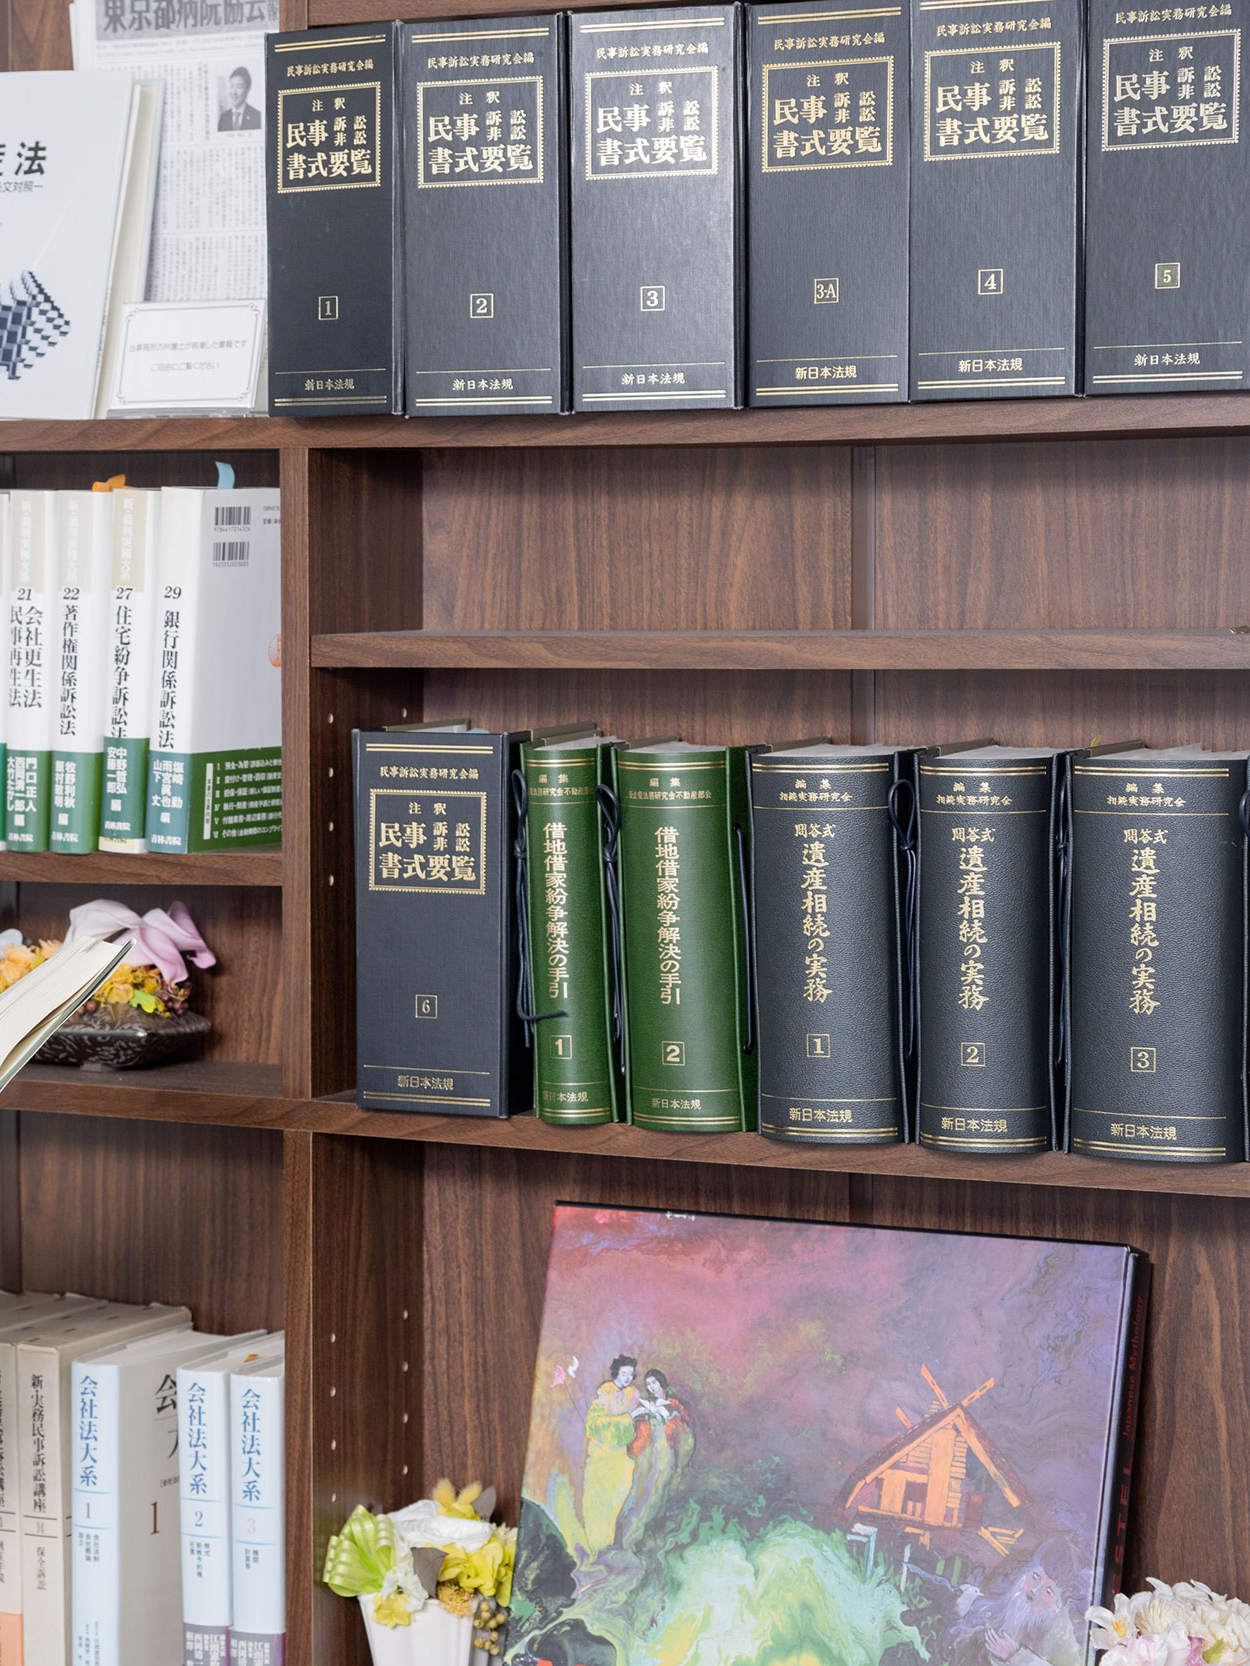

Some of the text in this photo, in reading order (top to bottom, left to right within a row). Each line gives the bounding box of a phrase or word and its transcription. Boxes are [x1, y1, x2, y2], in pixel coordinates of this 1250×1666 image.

[1116, 4, 1231, 24] 民事訴訟実務研究会編
[937, 17, 1051, 36] 民事訴訟実務研究会編
[775, 32, 884, 50] 民事訴訟実務研究会編
[597, 42, 708, 59] 民事訴訟実務研究会編
[1150, 47, 1193, 62] 注釈
[287, 59, 373, 76] 民事訴訟実務研究会編
[428, 52, 534, 69] 民事訴訟実務研究会編
[971, 59, 1014, 73] 注釈
[630, 81, 672, 95] 注釈
[807, 73, 848, 87] 注釈
[1114, 71, 1170, 102] 民事
[313, 98, 345, 111] 注釈
[460, 91, 500, 105] 注釈
[936, 83, 991, 113] 民事
[597, 104, 651, 133] 民事
[774, 96, 827, 125] 民事
[1114, 100, 1227, 136] 書式要覧
[286, 120, 328, 148] 民事
[428, 114, 479, 142] 民事
[936, 111, 1051, 149] 書式要覧
[597, 132, 707, 166] 書式要覧
[774, 123, 882, 158] 書式要覧
[287, 146, 375, 183] 書式要覧
[429, 141, 533, 174] 書式要覧
[985, 273, 996, 290] 4
[1163, 269, 1172, 284] 5
[646, 290, 659, 307] 3
[817, 282, 836, 299] 3-A
[324, 300, 333, 316] 1
[477, 298, 488, 314] 2
[959, 358, 1022, 372] 新日本法規
[1134, 353, 1200, 366] 新日本法規
[622, 373, 685, 385] 新日本法規
[796, 366, 857, 379] 新日本法規
[305, 379, 354, 390] 新日本法規
[453, 379, 513, 390] 新日本法規
[17, 588, 32, 600] 21
[63, 588, 80, 600] 22
[116, 587, 134, 600] 27
[164, 586, 182, 599] 29
[8, 605, 23, 708] 民事再生法
[23, 605, 43, 708] 会社更生法
[59, 604, 78, 736] 著作権関係訴訟法
[158, 610, 180, 749] 銀行関係訴訟法
[381, 766, 478, 779] 民事訴訟実務研究会編
[25, 757, 38, 812] 門口正人
[780, 789, 852, 802] 相続実務研究会
[937, 792, 1012, 806] 相続実務研究会
[1107, 793, 1186, 807] 相続実務研究会
[409, 803, 446, 815] 注釈
[379, 822, 427, 848] 民事
[795, 823, 836, 838] 問答式
[952, 827, 995, 842] 問答式
[1124, 829, 1168, 844] 問答式
[379, 852, 476, 881] 書式要覧
[543, 822, 569, 998] 借地借家紛争解決の手引
[655, 827, 681, 1004] 借地借家紛争解決の手引
[801, 841, 833, 1002] 遺産相続の実務
[958, 845, 989, 1010] 遺産相続の実務
[1129, 847, 1160, 1015] 遺産相続の実務
[422, 1000, 431, 1013] 6
[555, 1040, 564, 1056] 1
[667, 1046, 680, 1061] 2
[813, 1039, 823, 1053] 1
[967, 1048, 979, 1063] 2
[1137, 1052, 1149, 1068] 3
[398, 1076, 454, 1090] 新日本法規
[654, 1099, 702, 1110] 新日本法規
[790, 1108, 852, 1122] 新日本法規
[942, 1117, 1007, 1132] 新日本法規
[1111, 1124, 1177, 1140] 新日本法規
[80, 1375, 98, 1487] 会社法大系
[187, 1382, 208, 1495] 会社法大系
[30, 1374, 46, 1514] 新・実務民事訴訟講座
[242, 1388, 261, 1502] 会社法大系
[194, 1510, 204, 1528] 2
[247, 1517, 256, 1534] 3
